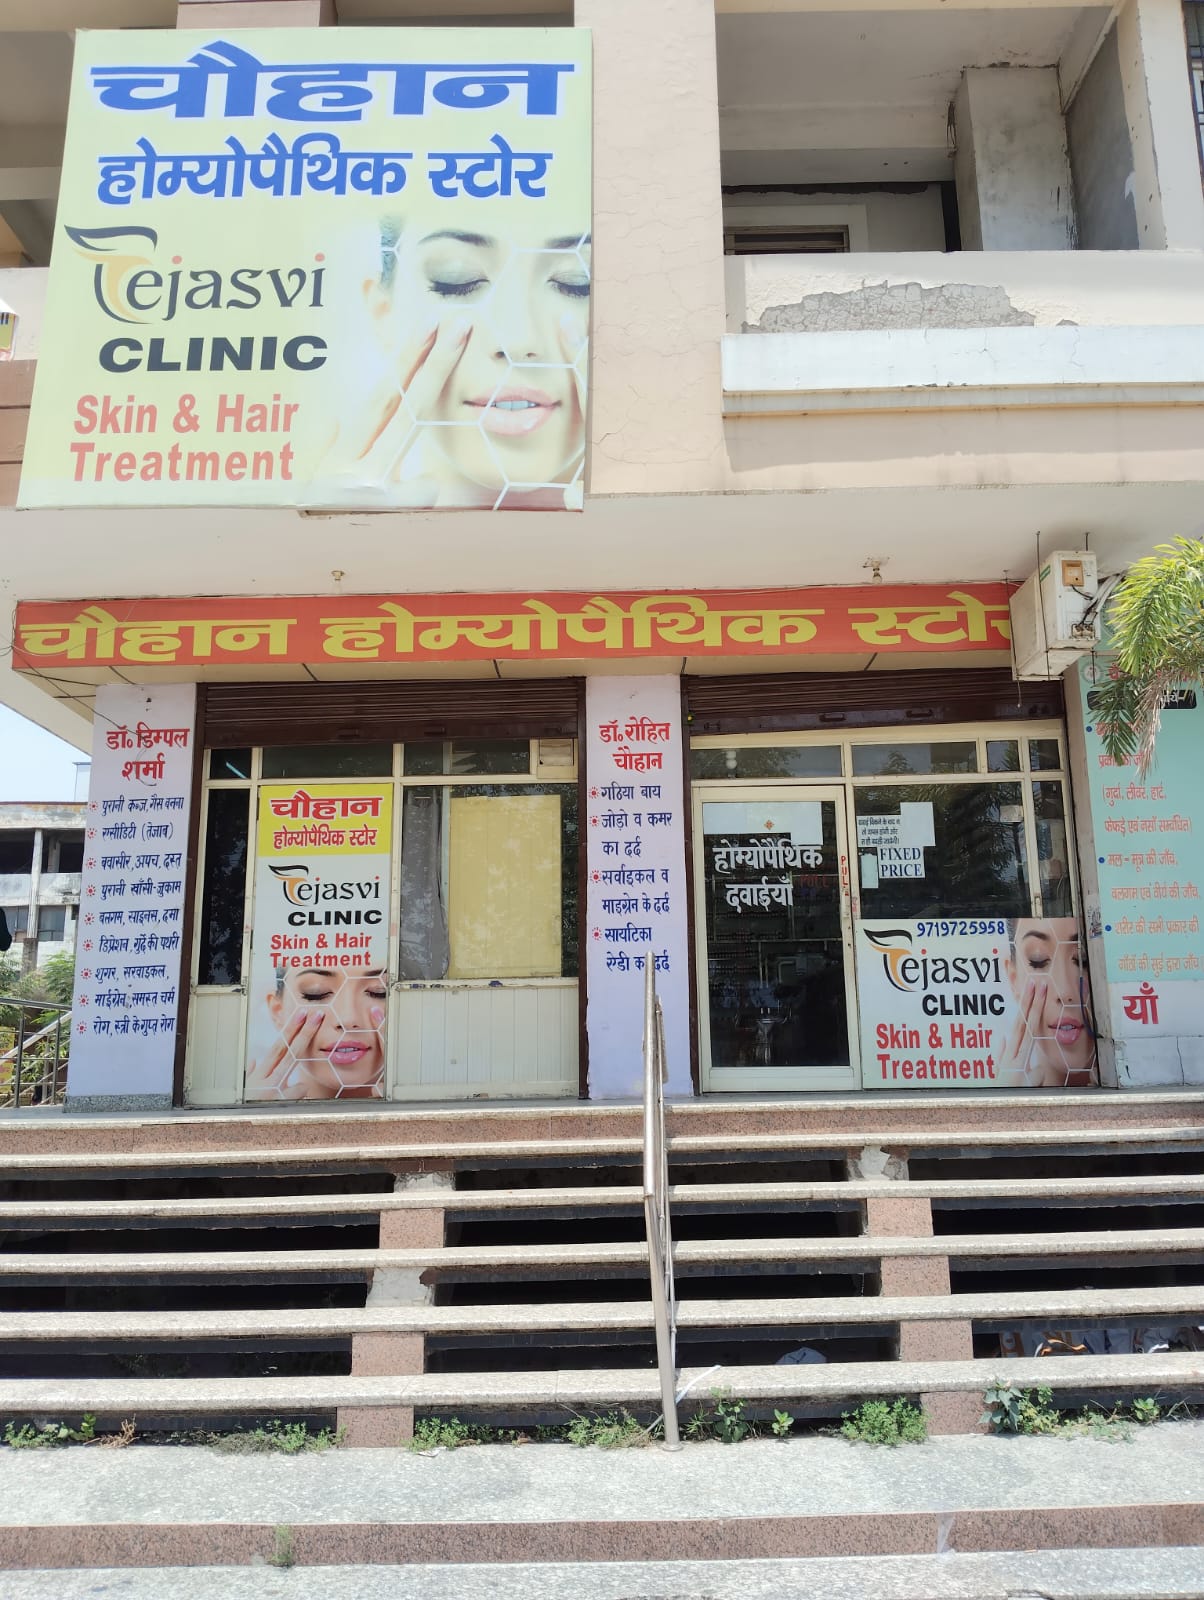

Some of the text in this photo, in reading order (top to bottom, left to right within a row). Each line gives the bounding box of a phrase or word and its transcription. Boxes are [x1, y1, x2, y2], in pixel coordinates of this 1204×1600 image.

[90, 40, 575, 122] चौहान
[97, 132, 553, 205] होम्योपैथिक स्टोर
[63, 224, 326, 325] Tejasvi
[99, 335, 328, 374] CLINIC
[73, 393, 299, 434] Skin & Hair
[69, 442, 294, 482] Treatment
[18, 604, 298, 663] चौहान
[319, 595, 825, 663] होम्योपैथिक
[135, 721, 190, 748] डिम्पल
[624, 716, 671, 744] रोहित
[121, 752, 166, 781] शर्मा
[600, 781, 661, 801] गठिया बाय
[102, 795, 125, 816] पुरानी
[149, 794, 164, 812] गैस
[270, 789, 383, 820] चौहान
[633, 813, 642, 827] व
[647, 812, 672, 827] कमर
[273, 823, 378, 850] होम्योपैथिक स्टोर
[602, 835, 642, 857] का दर्द
[163, 853, 182, 871] दस्त
[880, 847, 921, 861] FIXED
[601, 863, 669, 887] सर्वाइकल व
[881, 863, 923, 877] PRICE
[101, 879, 126, 900] पुरानी
[268, 864, 381, 906] Tejasvi
[725, 875, 794, 913] दवाईयाँ
[162, 908, 180, 922] दमा
[642, 892, 651, 912] के
[653, 891, 670, 915] दर्द
[287, 910, 383, 927] CLINIC
[916, 921, 1005, 937] 9719725958
[147, 933, 159, 951] की
[160, 931, 180, 950] पथरी
[270, 932, 372, 951] Skin & Hair
[605, 922, 653, 942] सायटिका
[270, 951, 371, 969] Treatment
[863, 928, 1002, 993] Tejasvi
[160, 986, 175, 1004] चर्म
[922, 994, 1005, 1017] CLINIC
[115, 1015, 130, 1034] स्त्री
[160, 1014, 175, 1032] रोग
[876, 1023, 993, 1049] Skin & Hair
[876, 1053, 996, 1080] Treatment
